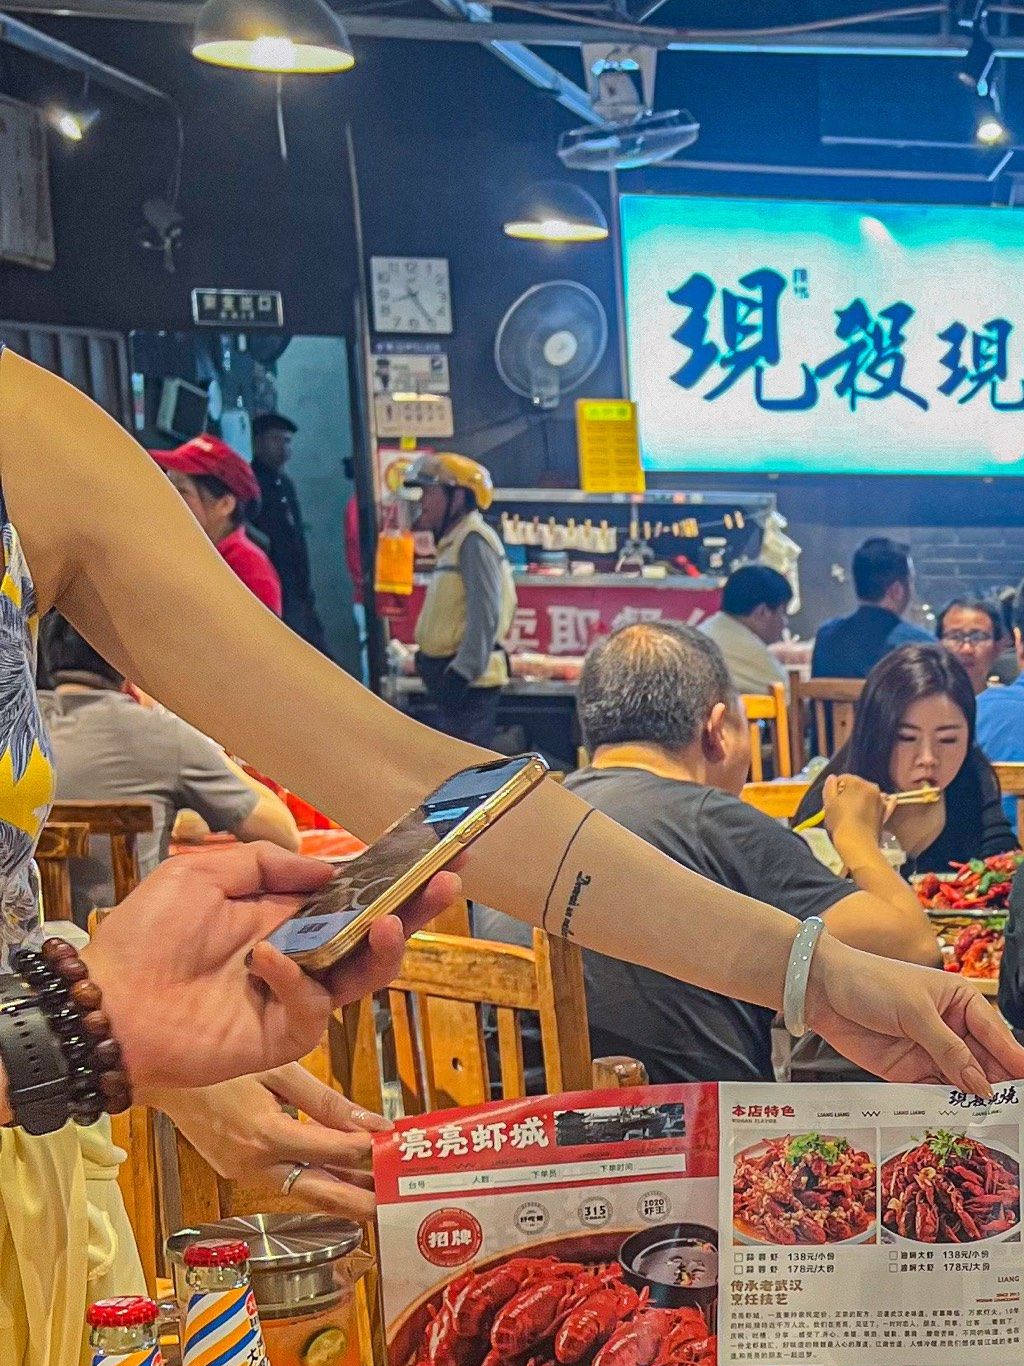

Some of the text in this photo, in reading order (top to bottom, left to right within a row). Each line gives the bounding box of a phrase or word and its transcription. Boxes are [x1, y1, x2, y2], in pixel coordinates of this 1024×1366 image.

[732, 1104, 796, 1118] 本店特色
[398, 1116, 549, 1162] 亮亮虾城
[644, 1199, 664, 1207] 2020
[584, 1205, 606, 1216] 315
[644, 1206, 665, 1215] 虾王
[428, 1229, 472, 1248] 招牌
[788, 1252, 835, 1261] 138元/小份
[943, 1250, 989, 1259] 138元/小份
[788, 1264, 834, 1274] 178元/大份
[943, 1263, 990, 1272] 178元/大份
[731, 1279, 803, 1292] 传承老武汉
[731, 1293, 788, 1306] 烹饪技艺
